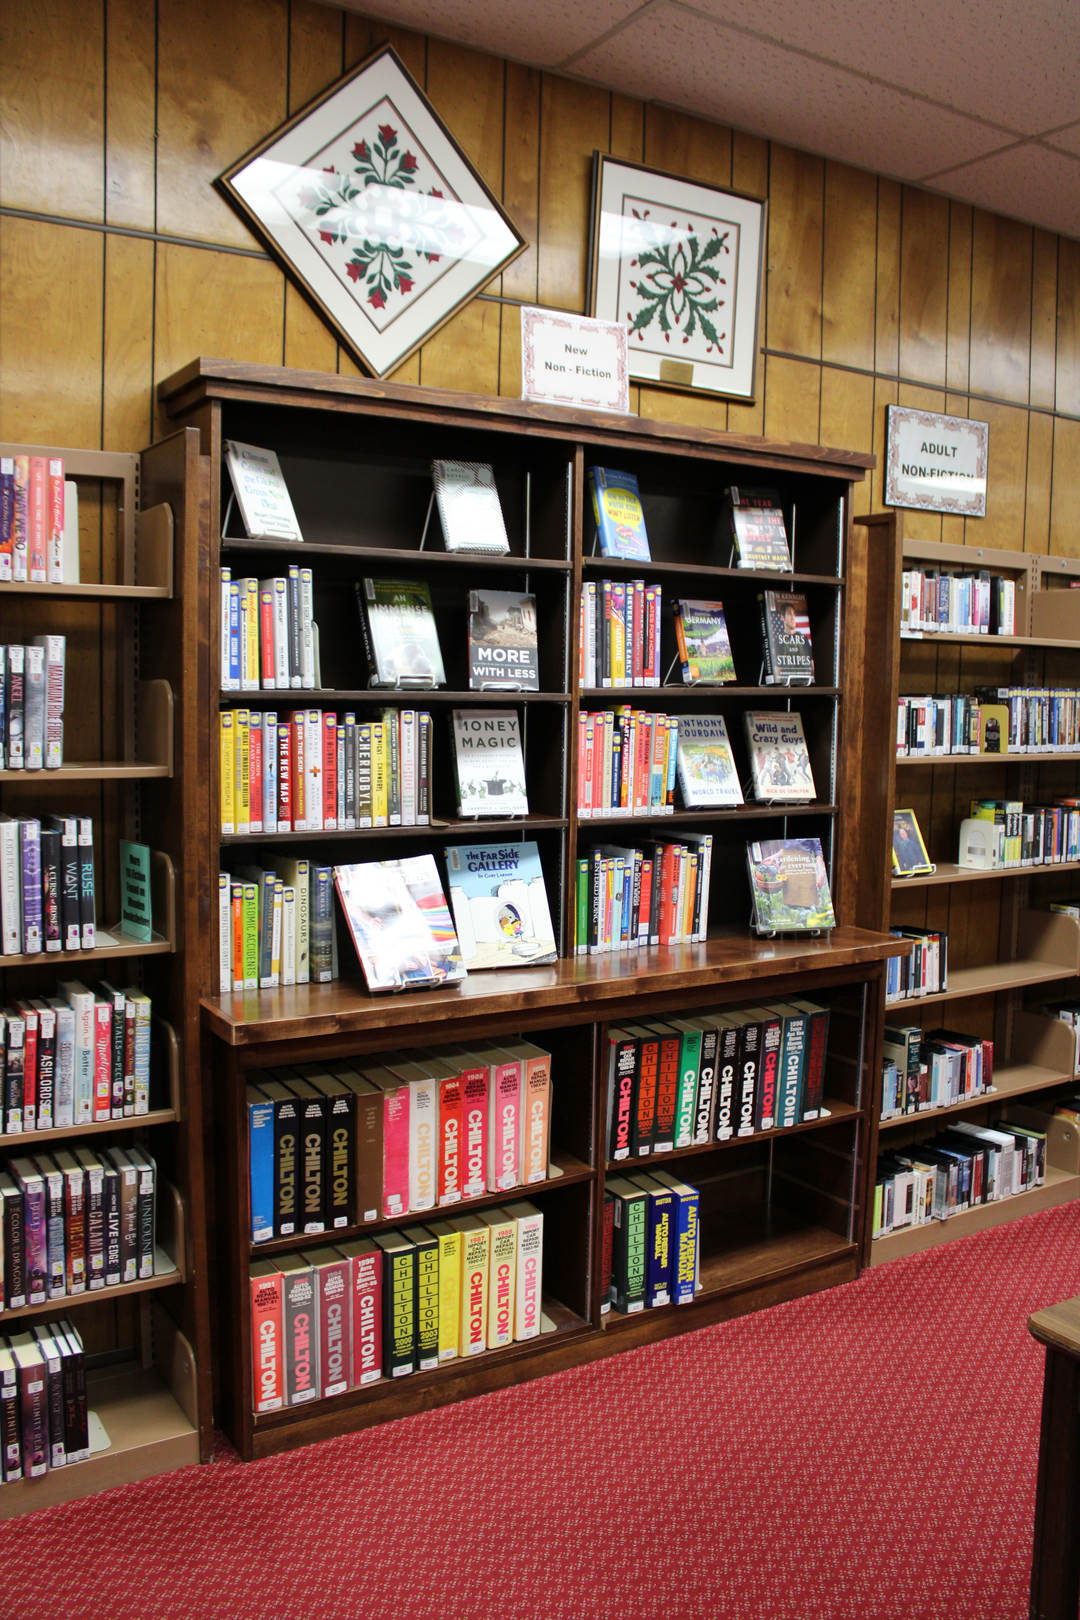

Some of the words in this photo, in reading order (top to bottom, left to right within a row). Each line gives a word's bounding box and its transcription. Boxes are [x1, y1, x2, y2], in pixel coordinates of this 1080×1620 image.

[564, 344, 588, 355] New
[545, 361, 565, 372] Non
[576, 366, 611, 379] Fiction
[242, 451, 269, 464] Climate
[921, 442, 957, 457] ADULT
[15, 484, 26, 515] AWAY
[244, 485, 267, 496] Green
[268, 490, 285, 500] New
[261, 499, 278, 510] Deal
[15, 519, 26, 535] WE
[624, 512, 640, 521] LISTEN
[15, 536, 25, 550] GO
[742, 534, 771, 542] HORSES
[373, 603, 428, 615] IMMENSE
[685, 616, 721, 624] GERMANY
[778, 635, 805, 645] SCARS
[478, 648, 530, 664] MORE
[777, 655, 811, 665] STRIPES
[48, 665, 63, 703] MAXIMUM
[472, 667, 505, 679] WITH
[508, 668, 536, 679] LESS
[11, 675, 22, 704] ANGEL
[30, 683, 41, 740] NEVERMORE
[48, 705, 62, 720] RIDE
[462, 737, 516, 748] MAGIC
[752, 734, 778, 745] Crazy
[781, 735, 804, 745] Guys
[755, 724, 778, 733] Wild
[781, 725, 798, 734] and
[280, 738, 288, 756] THE
[655, 736, 664, 762] RESORT
[280, 759, 288, 779] NEW
[359, 736, 370, 807] CHERNOBYL
[280, 783, 289, 803] MAP
[6, 858, 15, 894] PICOULT
[66, 862, 77, 900] WANT
[82, 864, 93, 897] RUSE
[468, 860, 519, 872] GALLERY
[246, 901, 255, 931] ATOMIC
[246, 934, 255, 976] ACCIDENTS
[82, 1050, 90, 1077] Better
[135, 1054, 149, 1065] IN
[502, 1068, 517, 1076] 1989
[39, 1055, 52, 1105] ASHLORDS
[642, 1044, 654, 1118] CHILTON
[662, 1041, 674, 1114] CHILTON
[762, 1052, 776, 1118] CHILTON
[784, 1056, 799, 1117] CHILTON
[680, 1070, 696, 1138] CHILTON
[697, 1068, 714, 1137] CHILTON
[719, 1065, 733, 1130] CHILTON
[741, 1062, 755, 1128] CHILTON
[616, 1077, 632, 1149] CHILTON
[468, 1110, 482, 1184] CHILTON
[503, 1104, 515, 1179] CHILTON
[531, 1100, 544, 1173] CHILTON
[333, 1128, 348, 1206] CHILTON
[417, 1122, 431, 1198] CHILTON
[445, 1118, 458, 1194] CHILTON
[279, 1134, 295, 1214] CHILTON
[305, 1134, 321, 1213] CHILTON
[126, 1197, 137, 1211] The
[11, 1213, 21, 1244] COLOR
[108, 1212, 118, 1237] LIVE
[125, 1213, 136, 1232] Hired
[688, 1206, 697, 1238] AUTO
[125, 1233, 136, 1246] Girl
[471, 1236, 485, 1244] 1987
[632, 1204, 640, 1274] CHILTON
[108, 1245, 119, 1265] EDGE
[358, 1257, 375, 1267] 1996
[678, 1232, 688, 1284] MANUAL
[686, 1240, 696, 1282] REPAIR
[12, 1252, 22, 1295] DRAGONS
[258, 1281, 275, 1289] 1991
[254, 1295, 279, 1304] MANUAL
[400, 1258, 408, 1336] CHILTON
[425, 1252, 434, 1329] CHILTON
[497, 1264, 510, 1334] CHILTON
[525, 1258, 536, 1328] CHILTON
[443, 1277, 456, 1349] CHILTON
[470, 1272, 482, 1344] CHILTON
[327, 1304, 343, 1382] CHILTON
[360, 1295, 375, 1369] CHILTON
[395, 1337, 412, 1347] 2000
[420, 1328, 438, 1339] 2003
[260, 1320, 276, 1399] CHILTON
[294, 1313, 311, 1391] CHILTON
[6, 1398, 17, 1443] INFINITY
[32, 1393, 42, 1430] INFINITY
